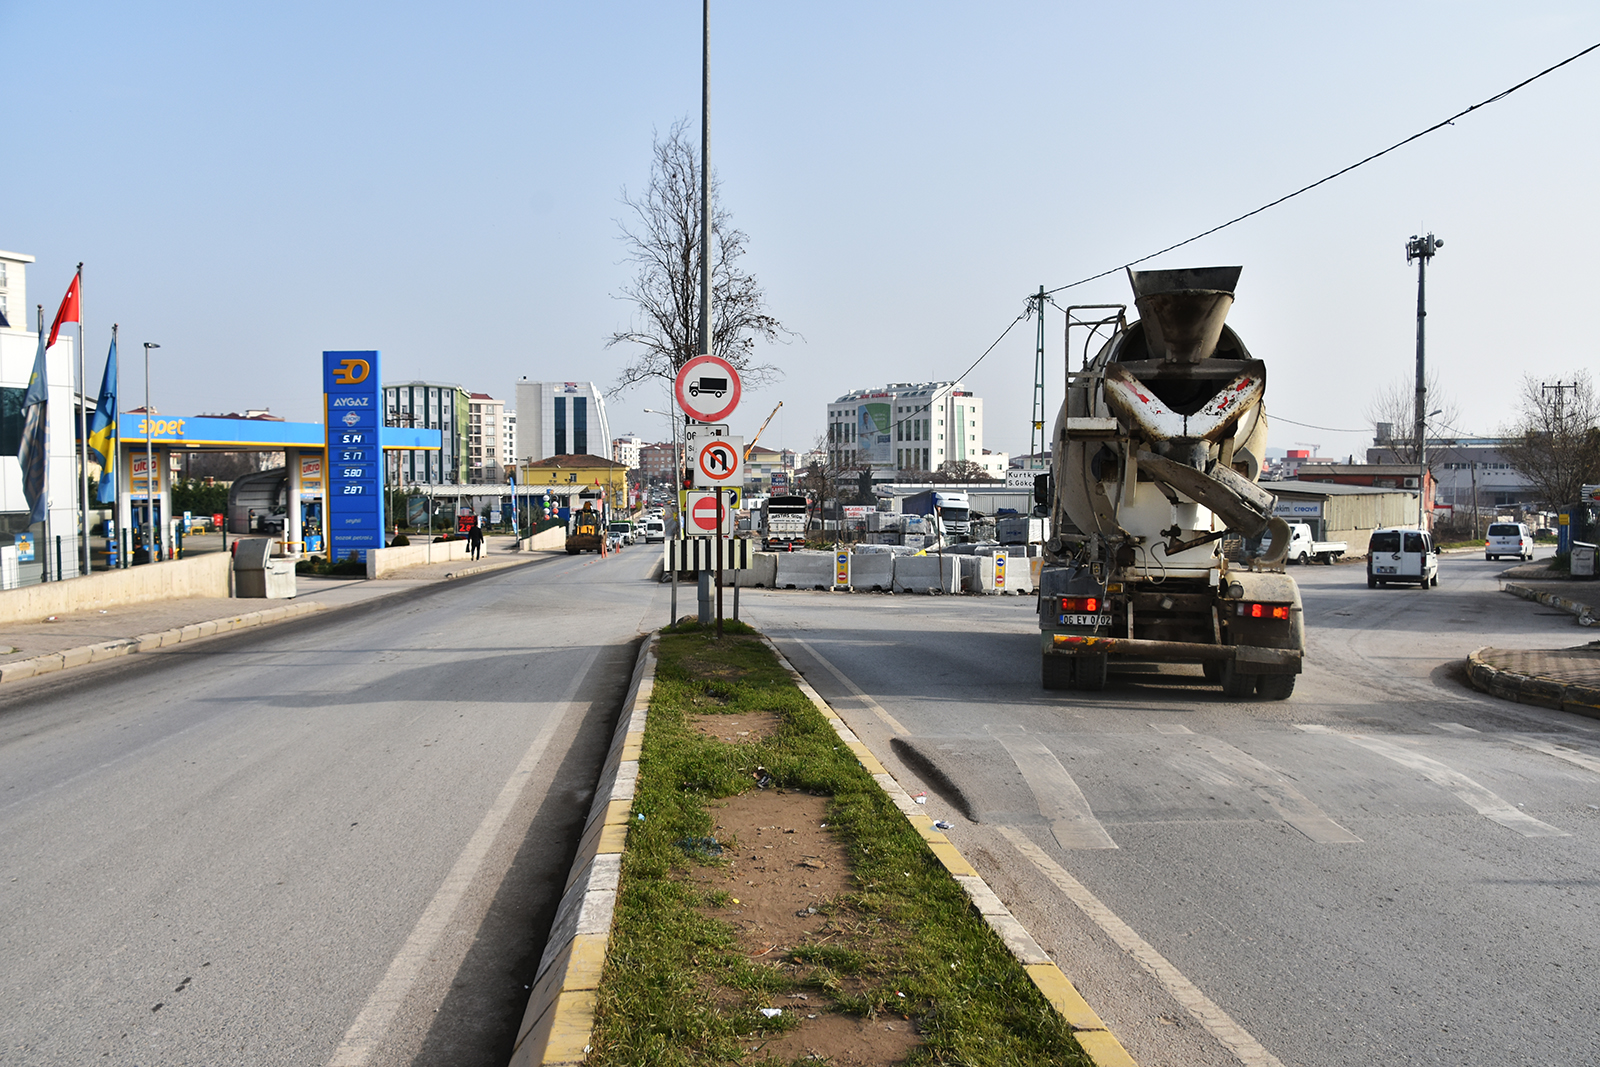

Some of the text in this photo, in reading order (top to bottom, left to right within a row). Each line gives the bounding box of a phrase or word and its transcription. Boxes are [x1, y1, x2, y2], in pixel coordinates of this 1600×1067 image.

[334, 397, 370, 407] AYGAZ
[1063, 615, 1074, 624] 06
[1090, 615, 1111, 625] 002
